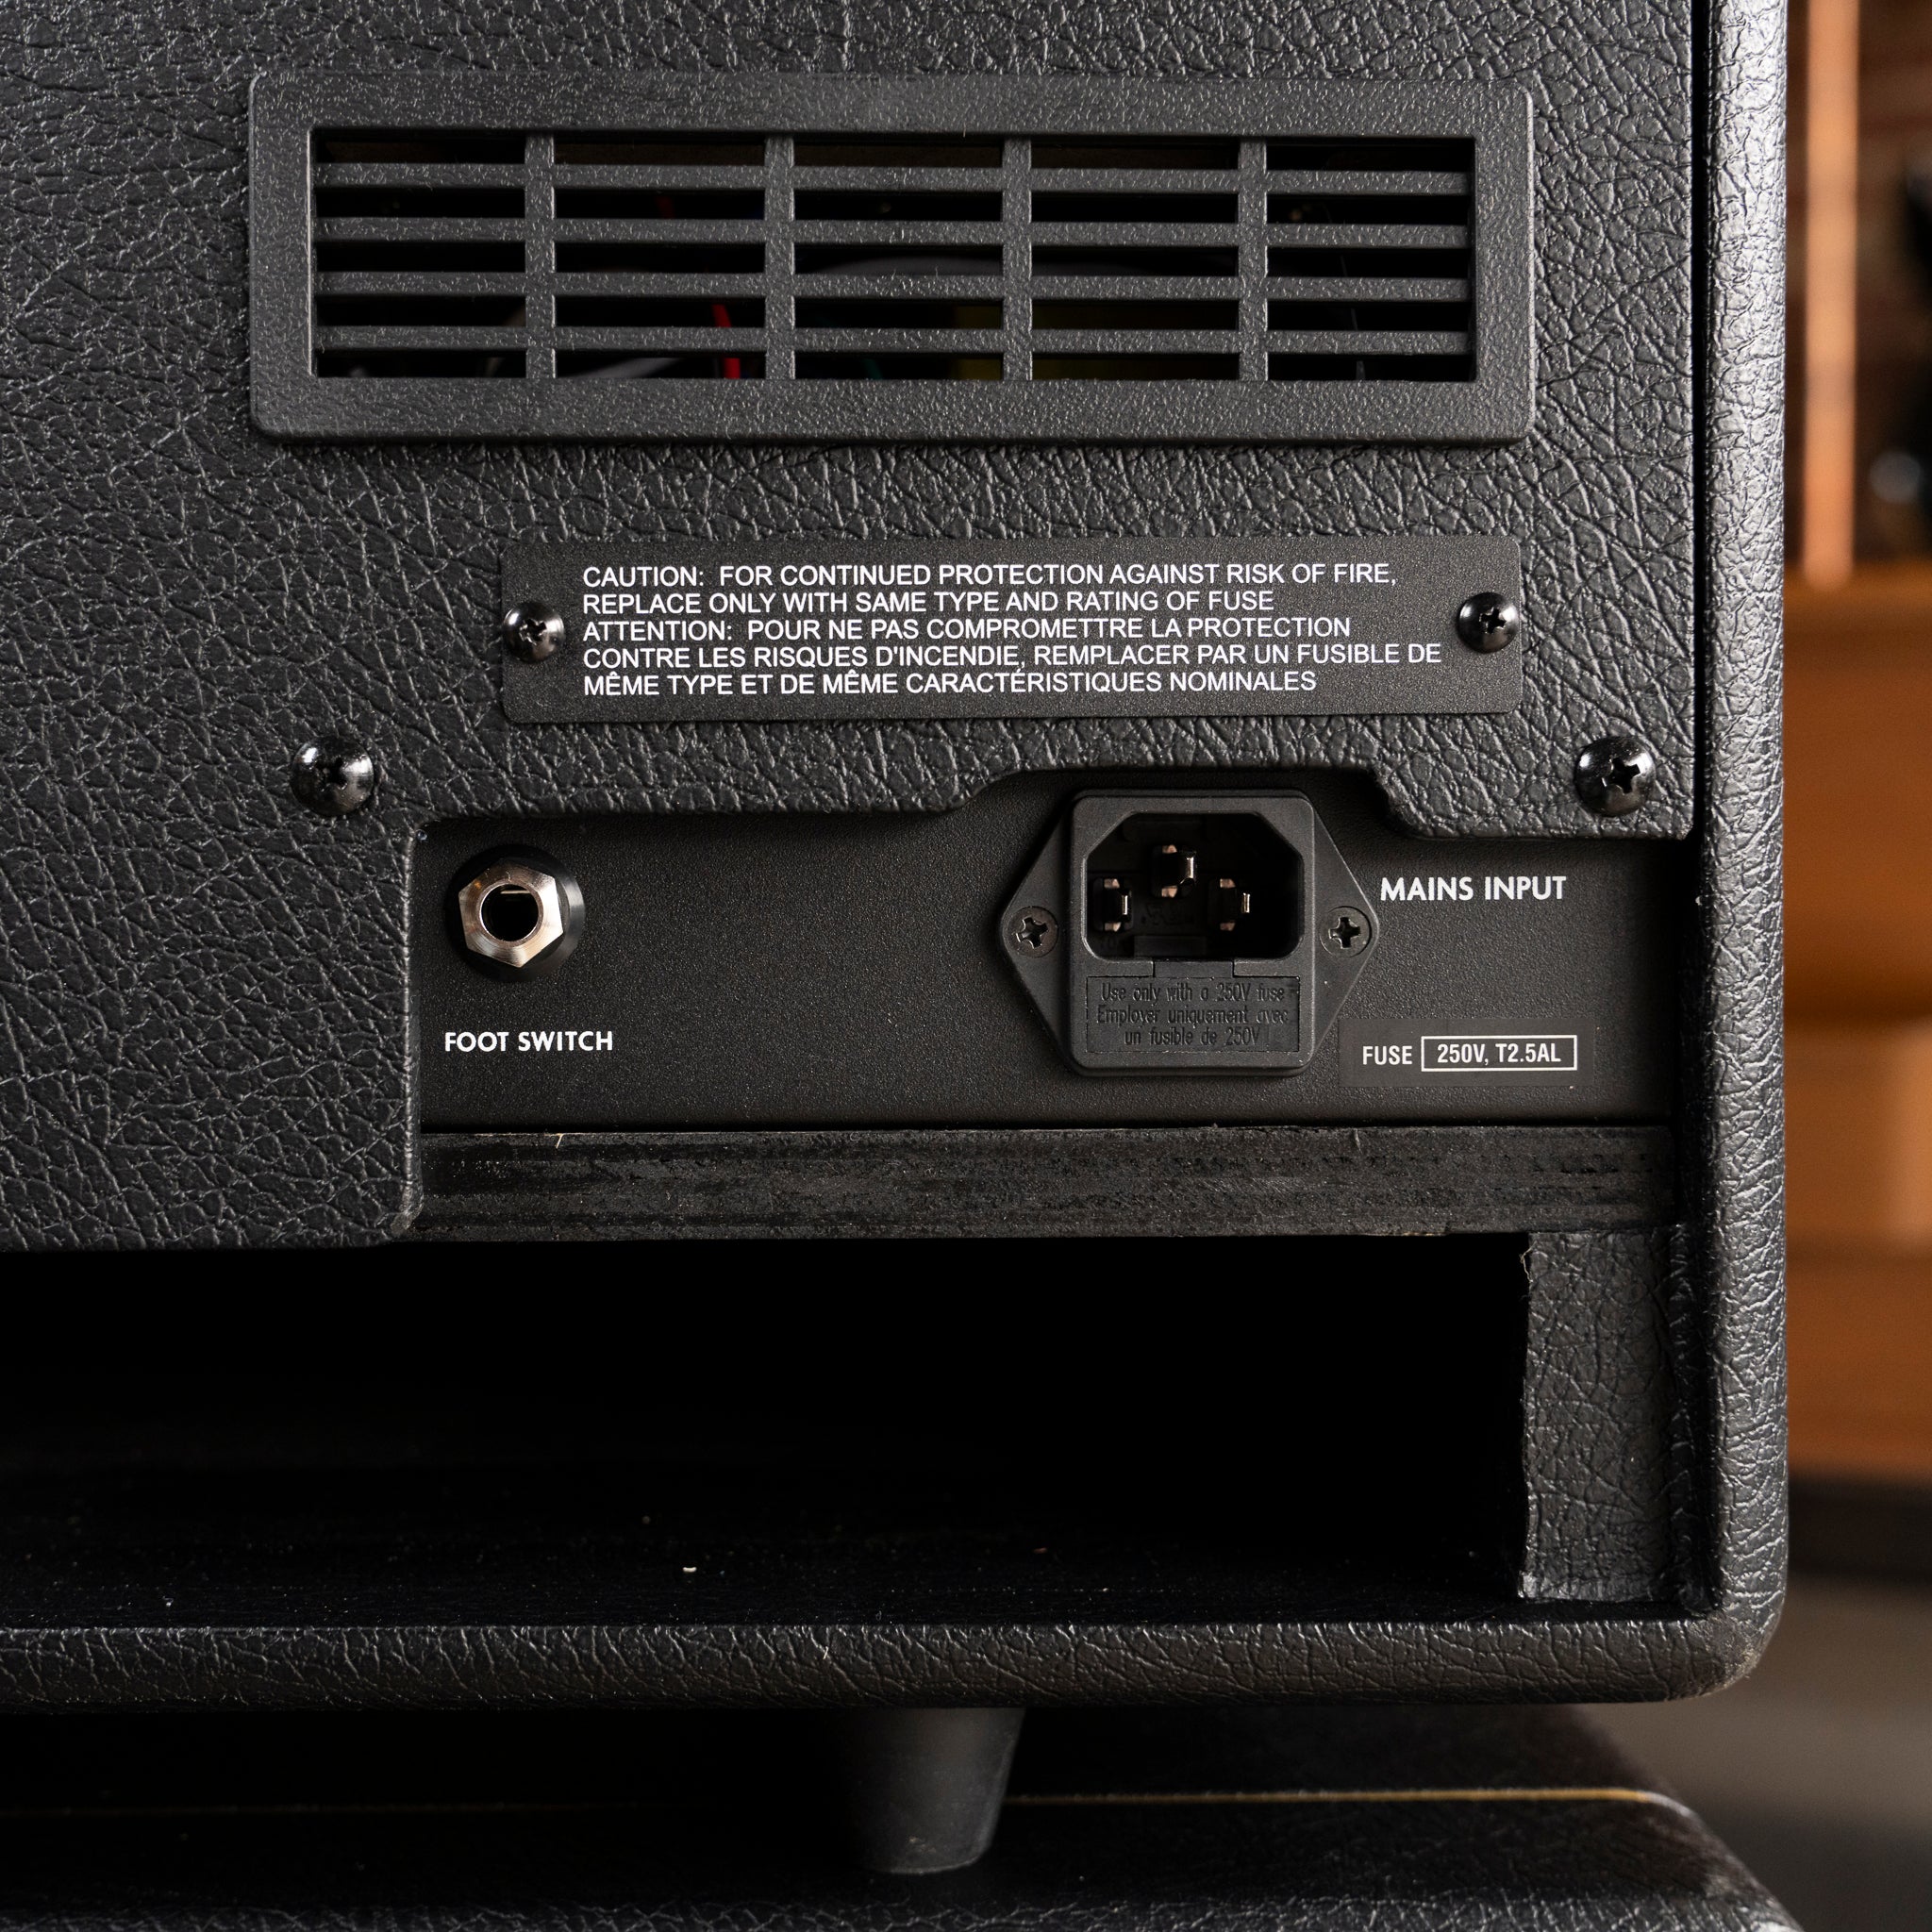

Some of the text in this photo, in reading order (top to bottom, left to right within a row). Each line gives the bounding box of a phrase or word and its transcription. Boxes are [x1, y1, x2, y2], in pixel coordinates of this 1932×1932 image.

[582, 560, 1397, 588] CAUTION: FOR CONTINUED PROTECTION AGAINST RISK OF FIRE,
[583, 588, 1274, 615] REPLACE ONLY WITH SAME TYPE AND RATING OF FUSE
[582, 615, 1353, 641] ATTENTION: POUR NE PAS COMPROMETTRE LA PROTECTION
[583, 641, 1442, 671] CONTRE LES RISQUES D'INCENDIE, REMPLACER PAR UN FUSIBLE DE
[584, 667, 1318, 696] MÊME TYPE ET DE MÊME CARACTÉRISTIQUES NOMINALES
[1380, 875, 1567, 902] MAINS INPUT
[1101, 983, 1125, 1001] Use
[1132, 983, 1160, 1005] only
[1167, 983, 1192, 1001] with
[1216, 983, 1251, 1001] 250V
[1257, 983, 1285, 1001] fuse
[1097, 1006, 1160, 1026] Employer
[1168, 1006, 1248, 1027] uniquement
[444, 1030, 613, 1053] FOOT SWITCH
[1124, 1026, 1259, 1045] un fusible de 250V
[1362, 1042, 1562, 1066] FUSE 250V, T2.5AL
